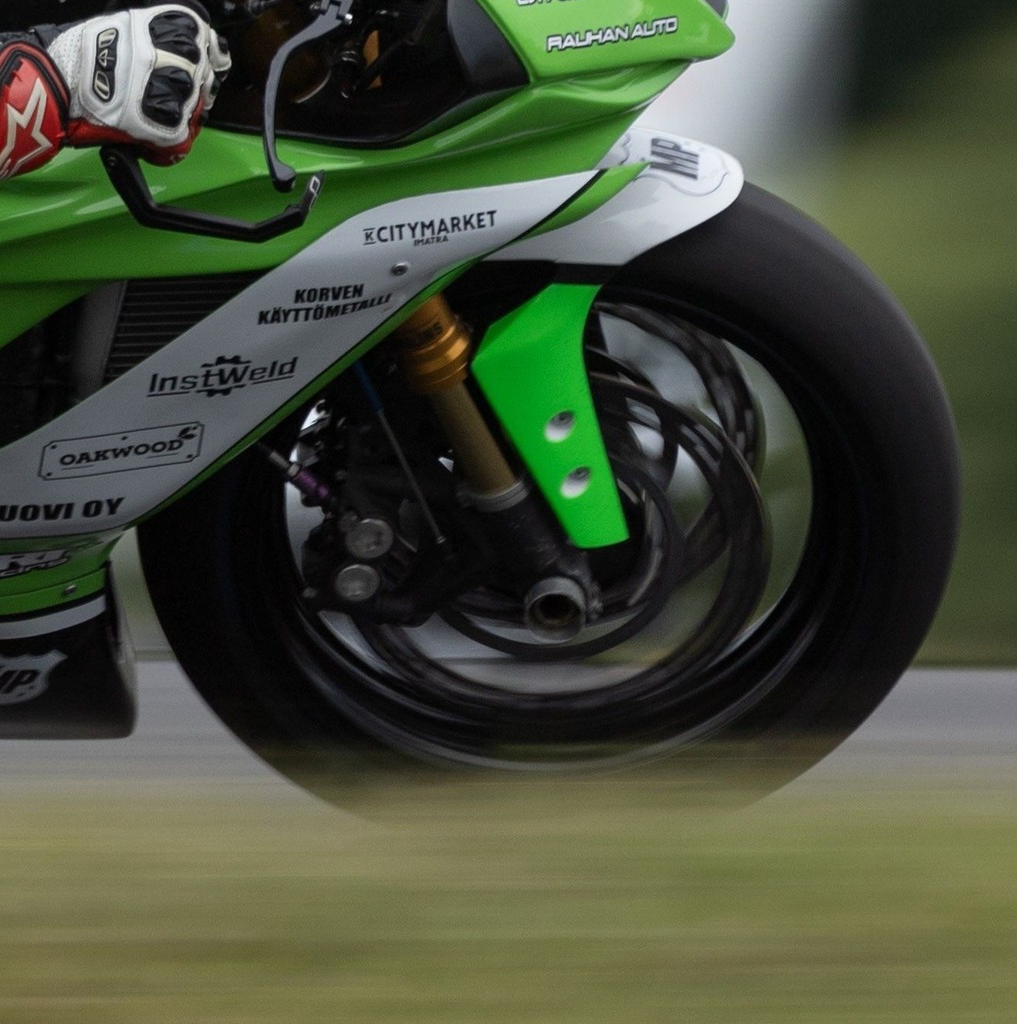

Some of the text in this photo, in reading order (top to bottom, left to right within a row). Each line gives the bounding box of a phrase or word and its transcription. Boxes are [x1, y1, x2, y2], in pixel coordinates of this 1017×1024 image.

[547, 17, 678, 52] RAUHAN AUTO
[414, 235, 449, 247] IMATRA
[294, 284, 364, 304] KORVEN
[258, 293, 392, 325] KÄYTTÖMETALLI
[148, 357, 298, 394] InstWeld
[59, 438, 184, 466] OAKWOOD
[81, 497, 125, 517] OY
